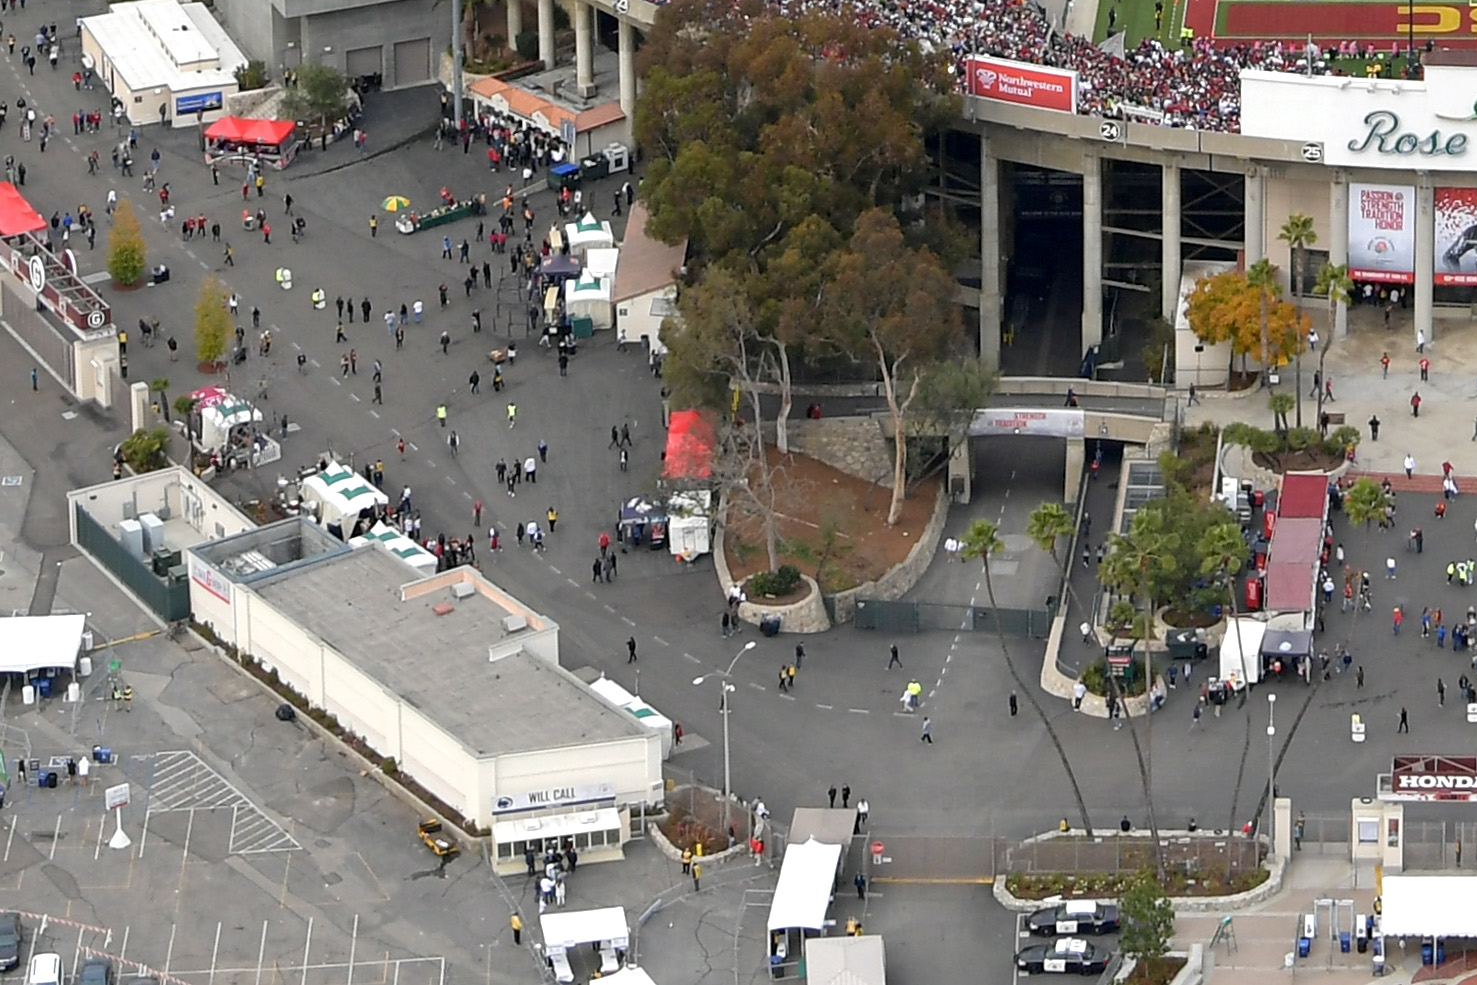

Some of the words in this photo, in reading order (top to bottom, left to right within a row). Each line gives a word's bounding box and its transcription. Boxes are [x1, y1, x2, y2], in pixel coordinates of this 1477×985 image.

[998, 72, 1064, 93] Northwestern
[998, 83, 1033, 97] Mutual
[1102, 125, 1117, 137] 24
[1347, 109, 1469, 157] Rose
[1304, 146, 1320, 158] 25
[1360, 189, 1394, 201] PASSION
[1360, 200, 1404, 212] STRENGTH
[1361, 209, 1403, 220] TRADITION
[1375, 219, 1403, 230] HONOR
[528, 790, 549, 804] WILL
[553, 787, 576, 801] CALL
